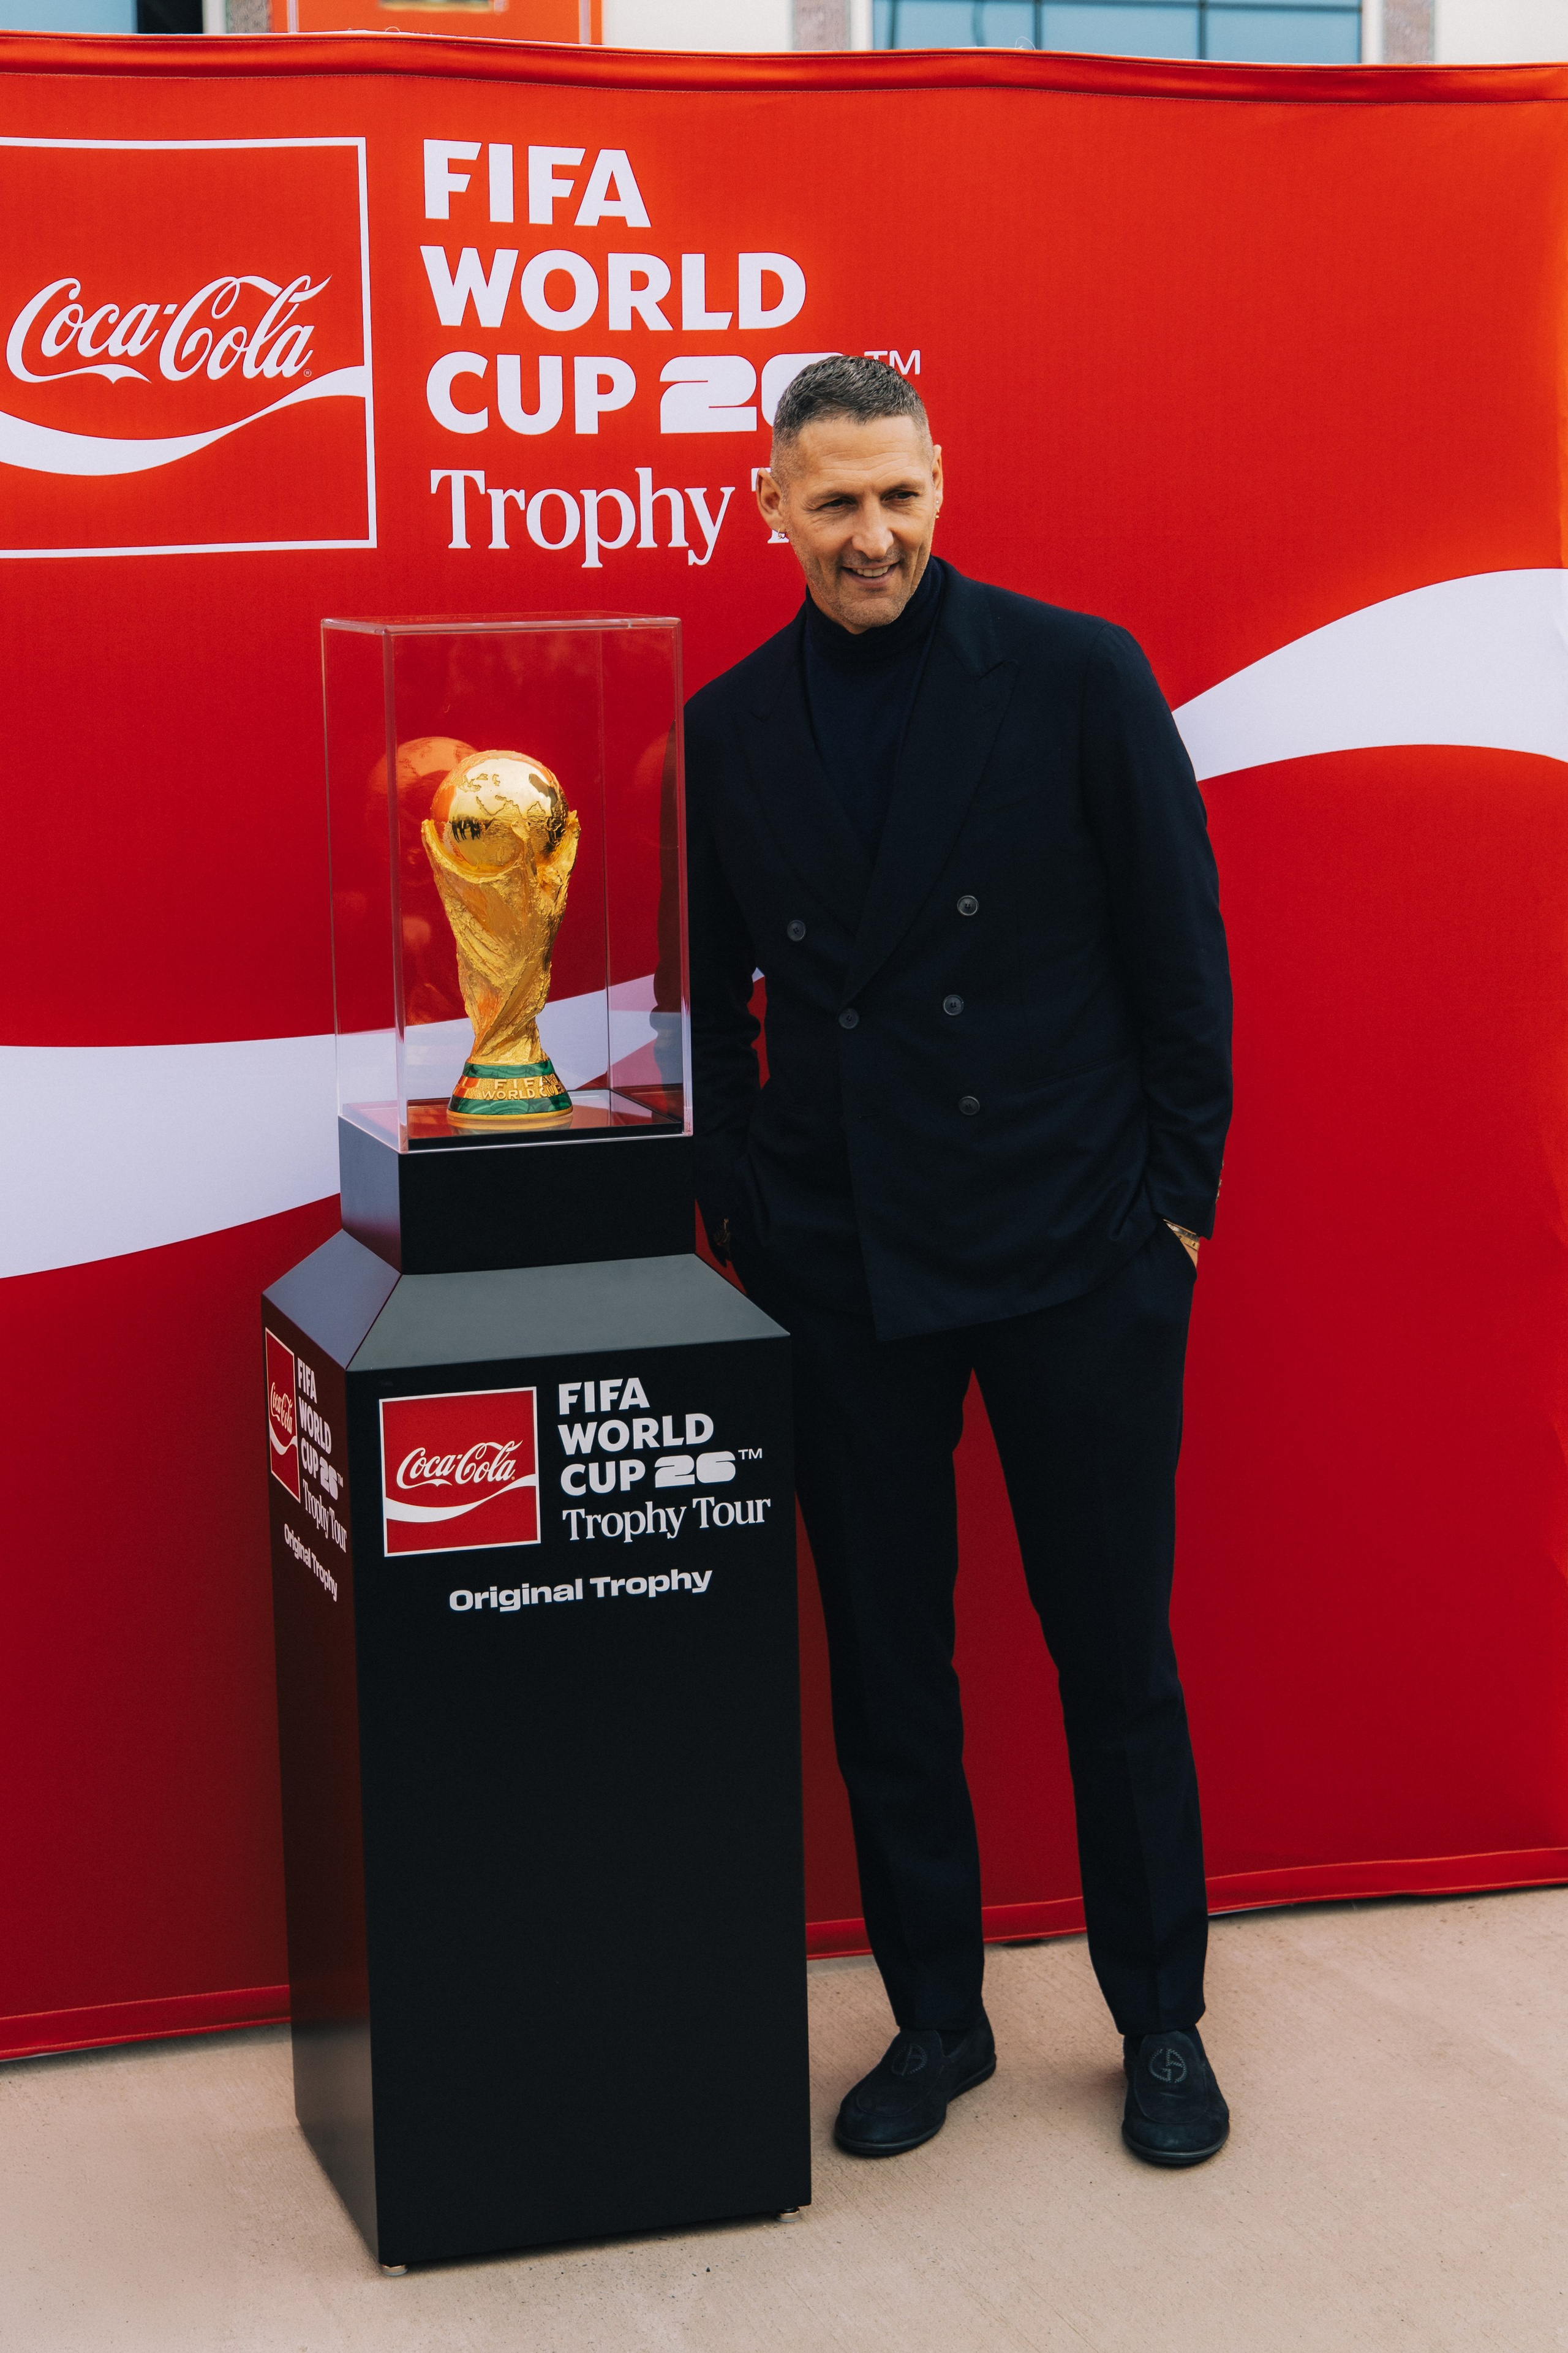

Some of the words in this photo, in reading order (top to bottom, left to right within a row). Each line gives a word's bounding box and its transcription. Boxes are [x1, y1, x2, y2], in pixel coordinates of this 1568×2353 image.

[424, 138, 651, 227] FIFA
[420, 245, 806, 331] WORLD
[426, 351, 636, 435] CUP
[431, 467, 736, 568] Trophy
[482, 1088, 535, 1100] WORLD
[494, 1076, 552, 1090] FIFA
[297, 1357, 317, 1403] FIFA
[559, 1377, 650, 1415] FIFA
[298, 1395, 331, 1455] WORLD
[557, 1413, 714, 1455] WORLD
[301, 1437, 319, 1479] CUP
[560, 1459, 646, 1496] CUP
[303, 1478, 330, 1539] Trophy
[329, 1506, 347, 1553] Tour
[562, 1501, 687, 1543] Trophy
[692, 1496, 771, 1528] Tour
[284, 1523, 311, 1569] Original
[311, 1552, 337, 1602] Trophy
[449, 1578, 583, 1612] Original
[589, 1568, 713, 1598] Trophy
